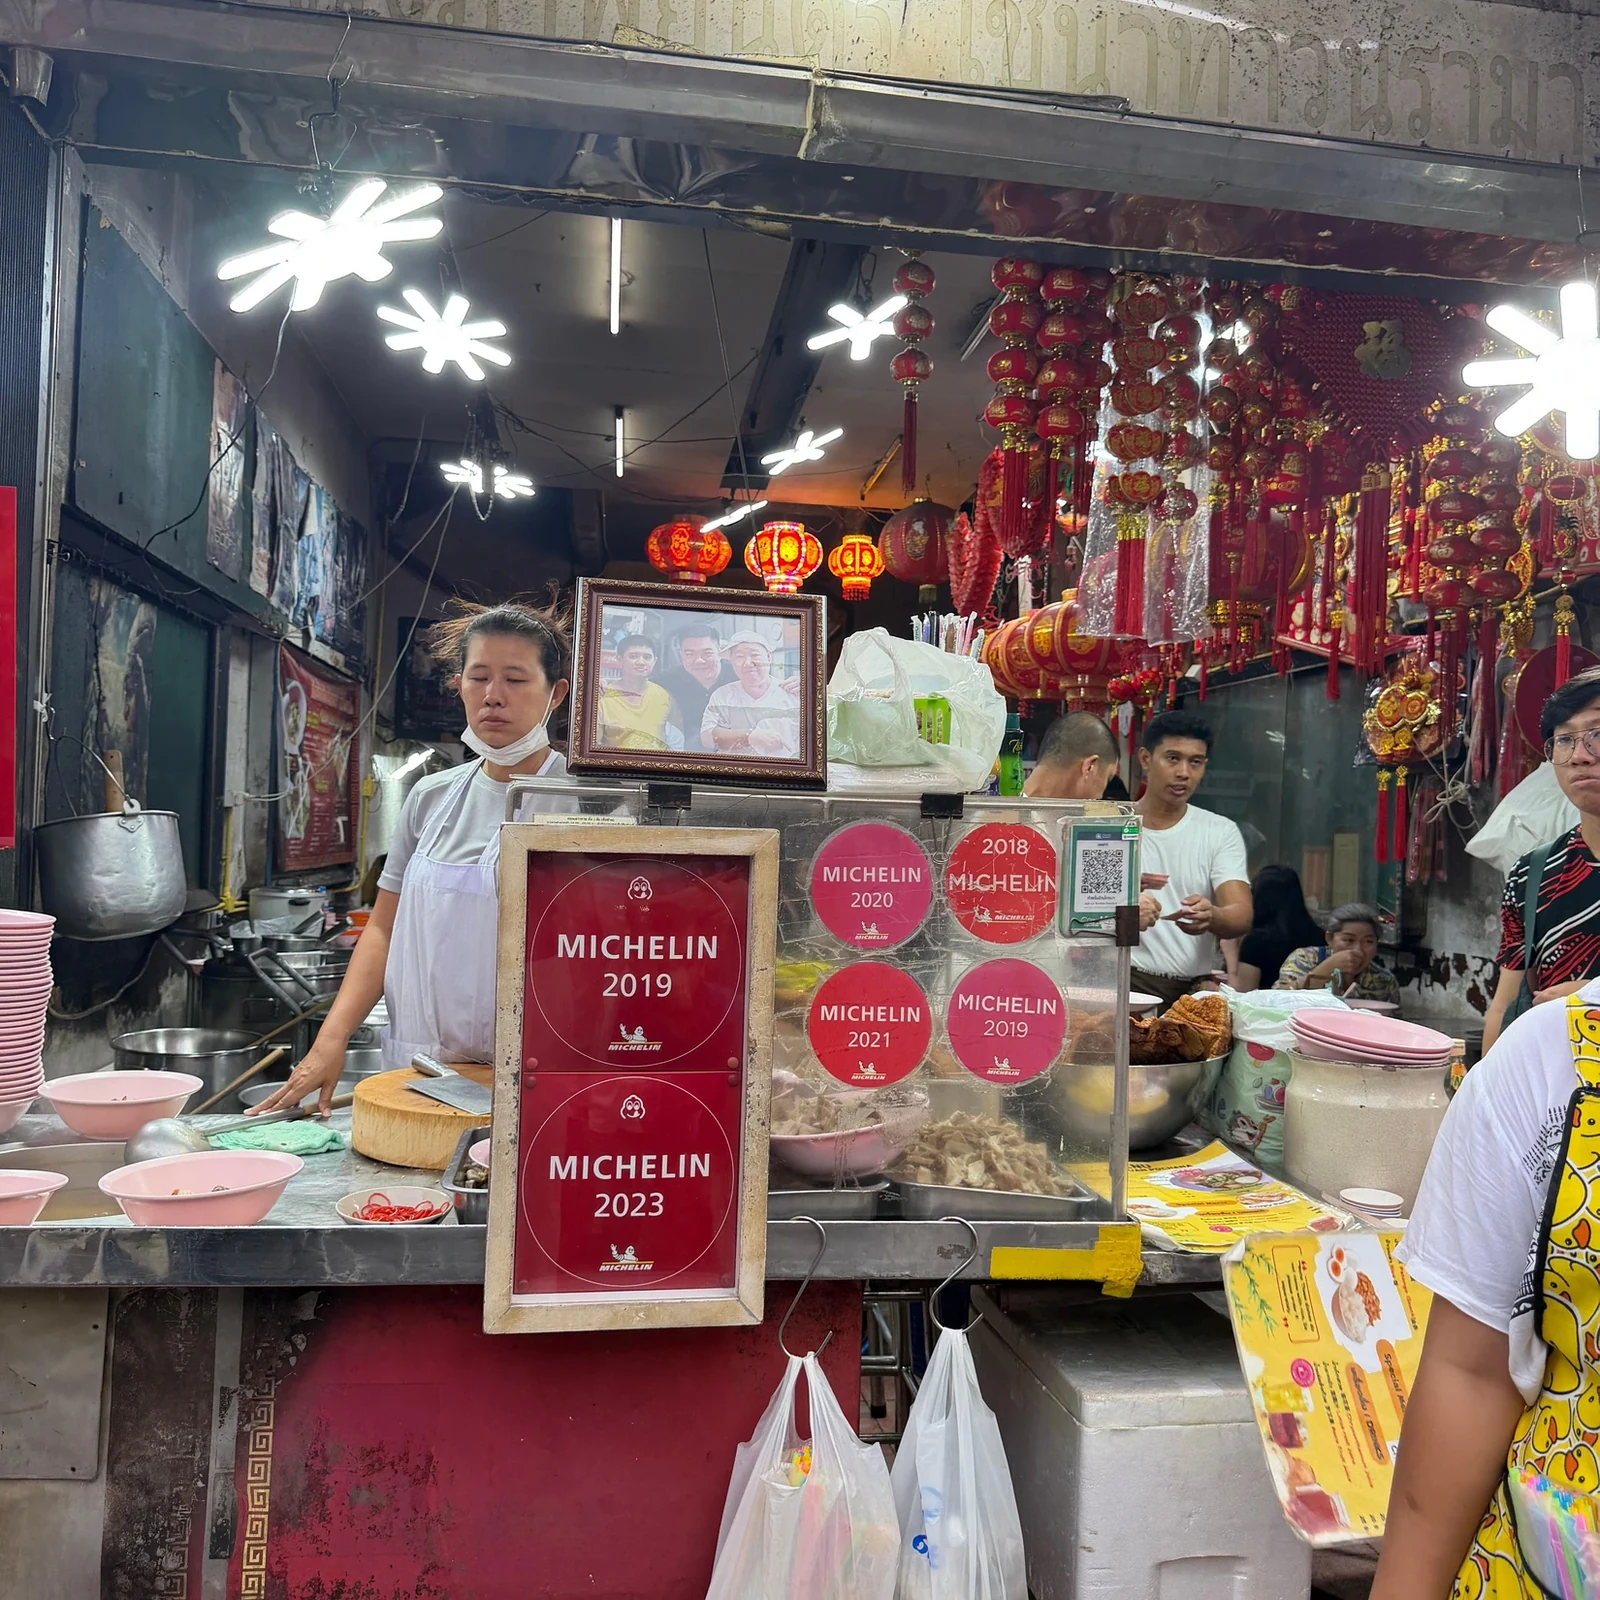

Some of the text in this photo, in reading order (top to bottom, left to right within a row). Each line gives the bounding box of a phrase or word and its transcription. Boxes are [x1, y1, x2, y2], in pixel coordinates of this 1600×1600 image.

[982, 838, 1028, 855] 2018
[823, 866, 921, 883] MICHELIN
[948, 873, 1057, 892] MICHELIN
[851, 892, 893, 908] 2020
[557, 934, 718, 960] MICHELIN
[602, 973, 672, 997] 2019
[958, 994, 1057, 1015] MICHELIN
[820, 1005, 921, 1023] MICHELIN
[983, 1020, 1028, 1038] 2019
[608, 1043, 662, 1051] MICHELIN
[848, 1031, 891, 1048] 2021
[549, 1153, 711, 1180] MICHELIN
[594, 1193, 664, 1218] 2023
[599, 1263, 653, 1271] MICHELIN
[1384, 1353, 1407, 1412] Special Me
